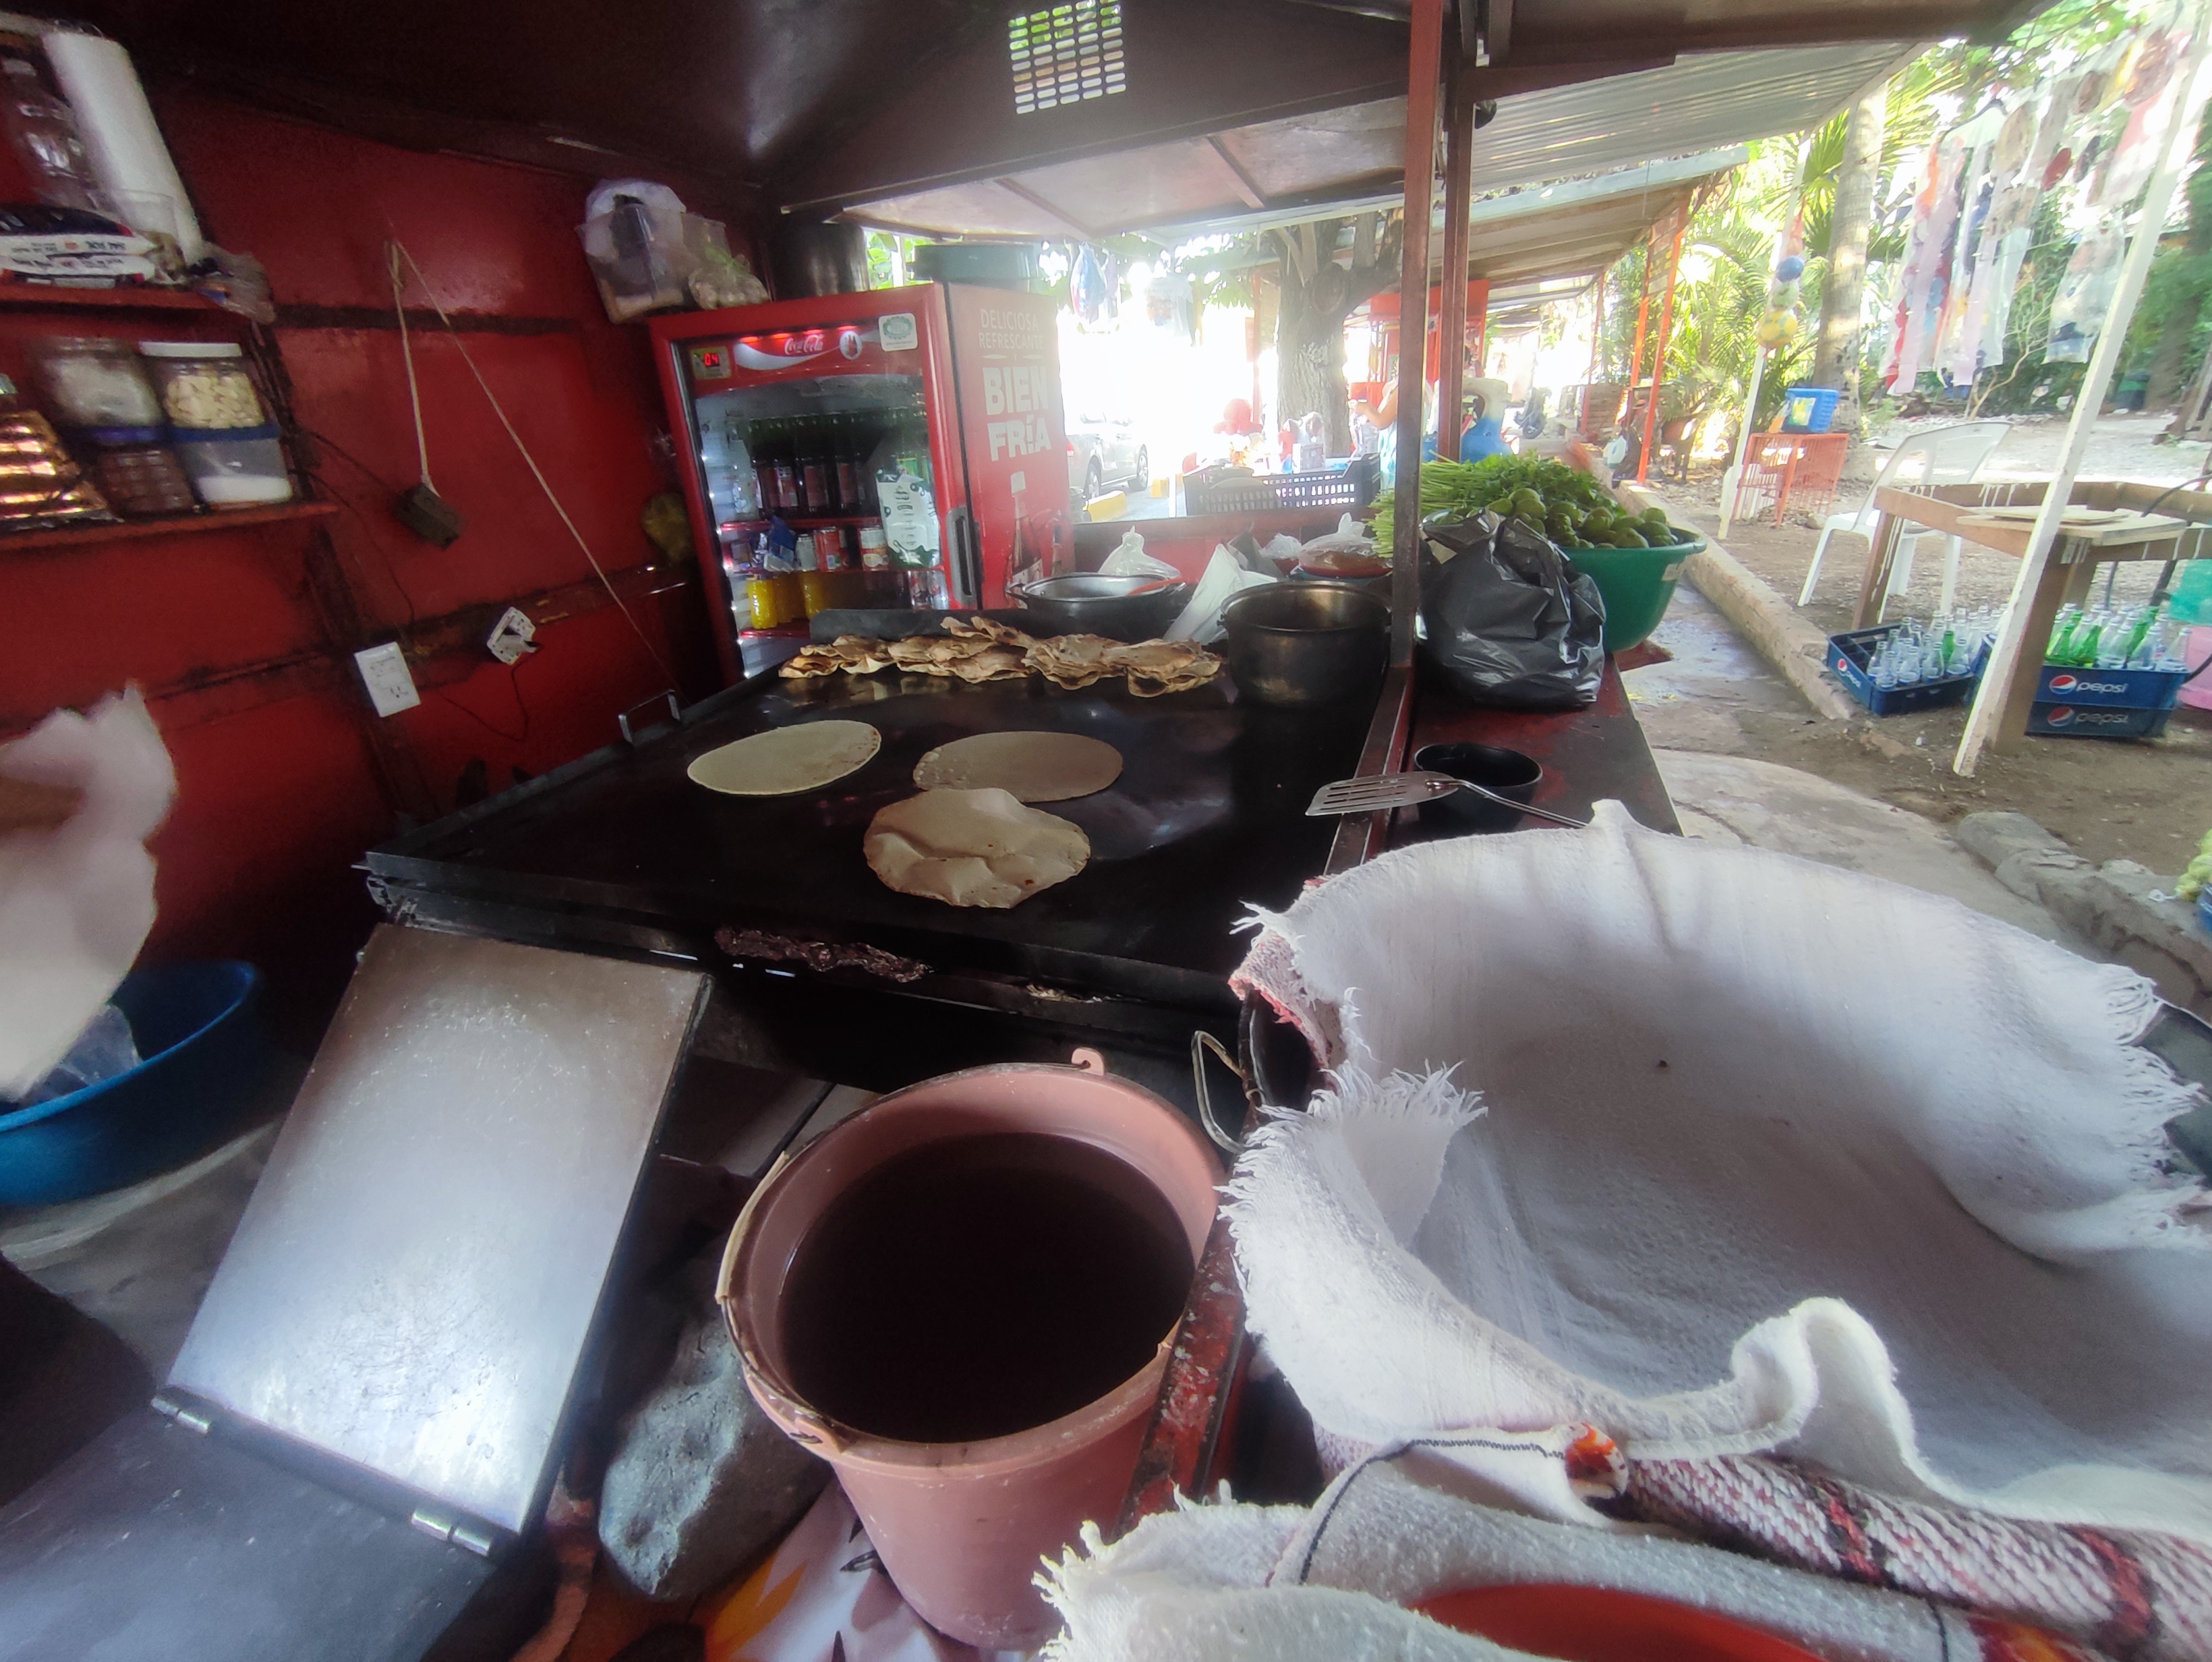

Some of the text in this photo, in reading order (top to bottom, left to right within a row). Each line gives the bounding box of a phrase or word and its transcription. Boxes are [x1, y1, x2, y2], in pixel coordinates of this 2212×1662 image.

[980, 309, 1040, 331] DELICIOSA
[979, 332, 1045, 349] REFRESCANTE
[704, 353, 719, 366] 04
[983, 366, 1049, 416] BIEN
[987, 414, 1052, 462] FRÍA
[2076, 681, 2128, 694] pepsi
[2074, 712, 2129, 726] pepsi
